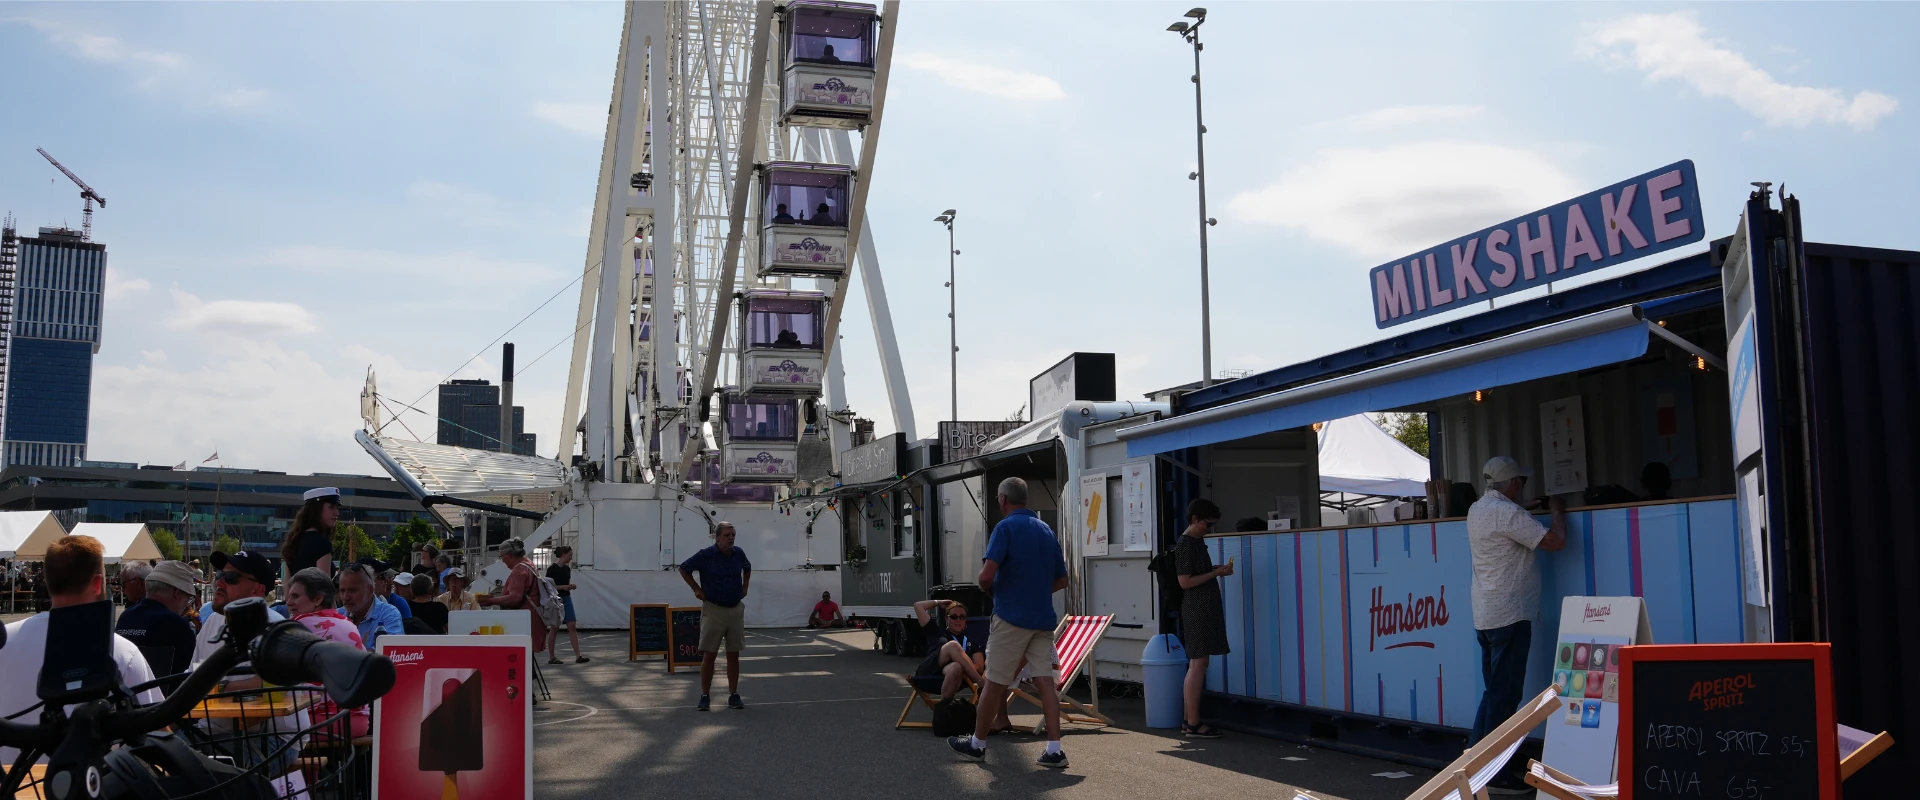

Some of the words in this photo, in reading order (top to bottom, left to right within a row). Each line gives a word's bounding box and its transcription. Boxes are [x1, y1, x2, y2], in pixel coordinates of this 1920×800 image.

[1375, 169, 1692, 323] MILKSHAKE
[1369, 584, 1450, 653] Hansens
[1582, 602, 1612, 624] Hansens
[389, 650, 425, 663] Hansens
[1688, 673, 1757, 701] APEROL
[1703, 692, 1745, 711] SPRITZ
[1646, 721, 1707, 756] APEROL
[1716, 730, 1771, 756] SPRITZ
[1644, 765, 1702, 796] CAVA
